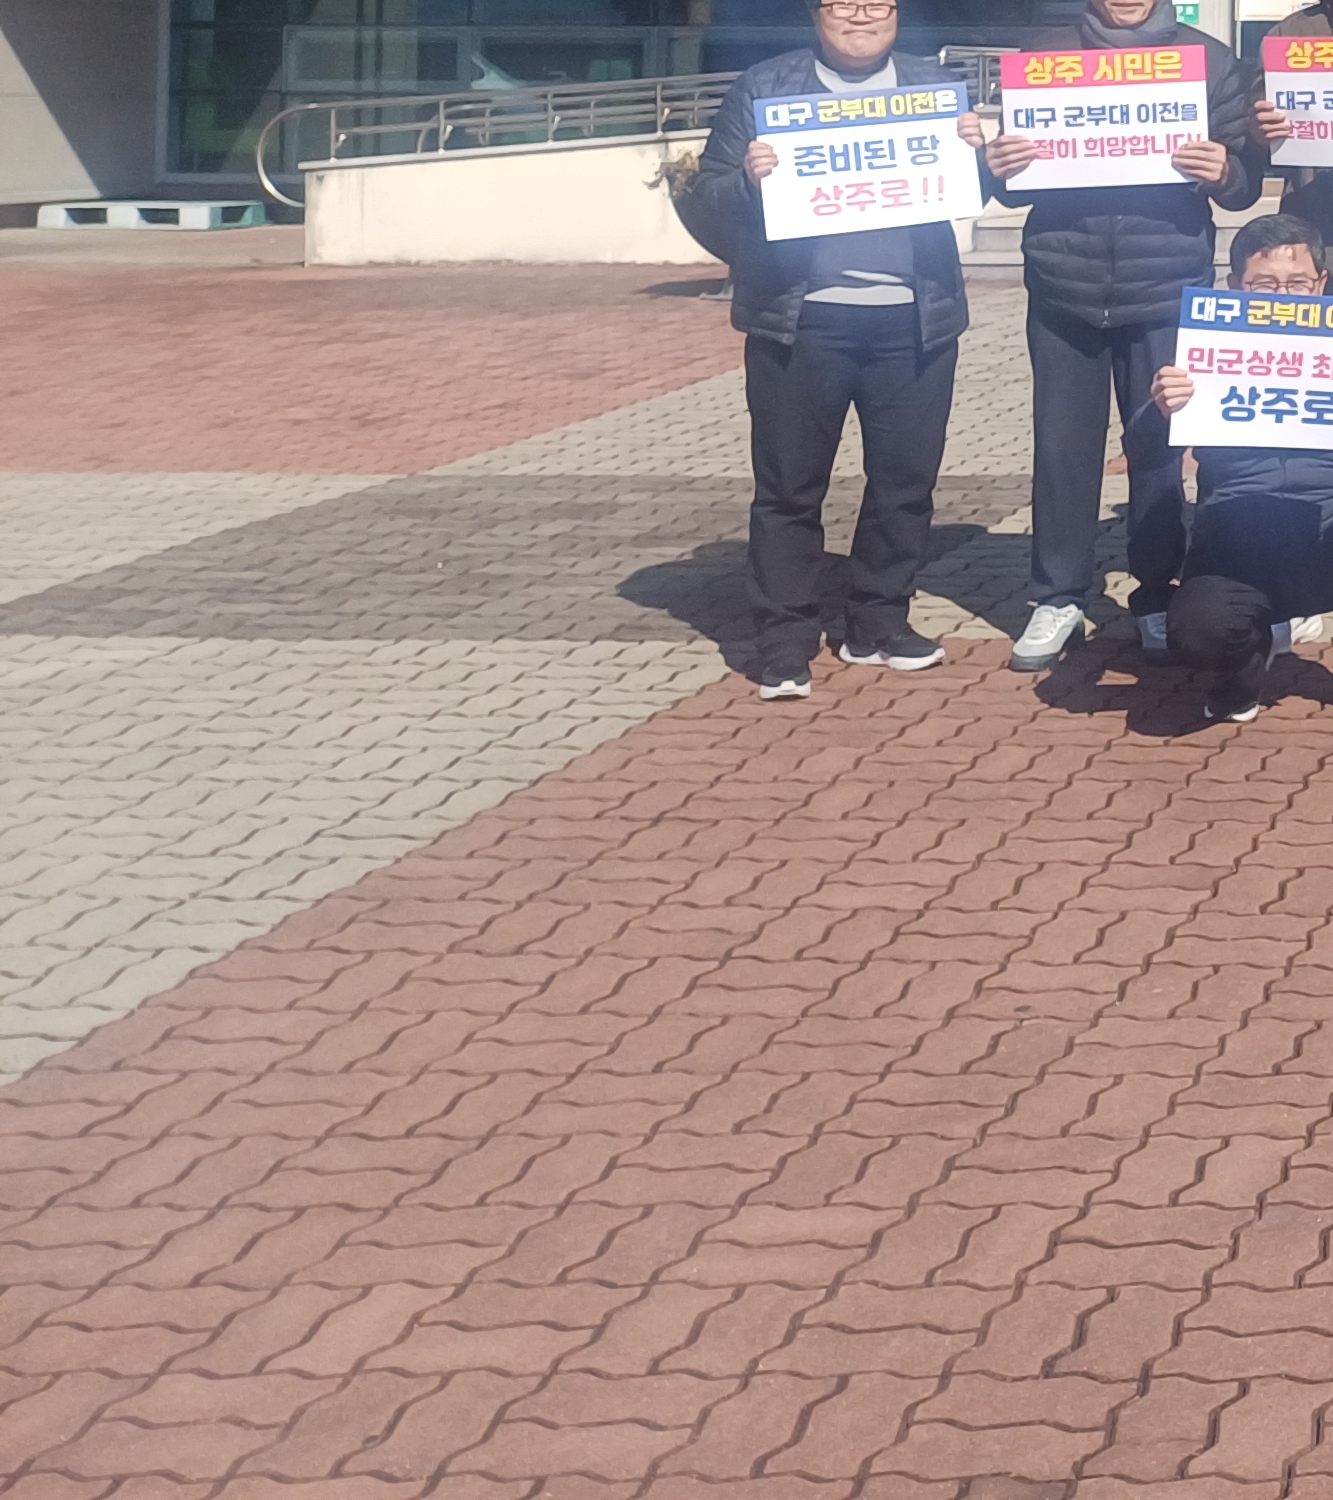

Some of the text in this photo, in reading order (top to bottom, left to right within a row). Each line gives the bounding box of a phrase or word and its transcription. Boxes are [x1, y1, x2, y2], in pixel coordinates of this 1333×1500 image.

[1024, 52, 1183, 84] 상주 시민은
[766, 90, 958, 127] 대구 군부대 이전은
[1014, 100, 1198, 130] 대구 군부대 이전을
[1276, 91, 1317, 110] 대구
[794, 135, 940, 177] 준비된 땅
[1033, 138, 1077, 159] 절히
[1190, 298, 1241, 323] 대구
[1247, 300, 1321, 328] 군부대
[1188, 348, 1303, 377] 민군상생
